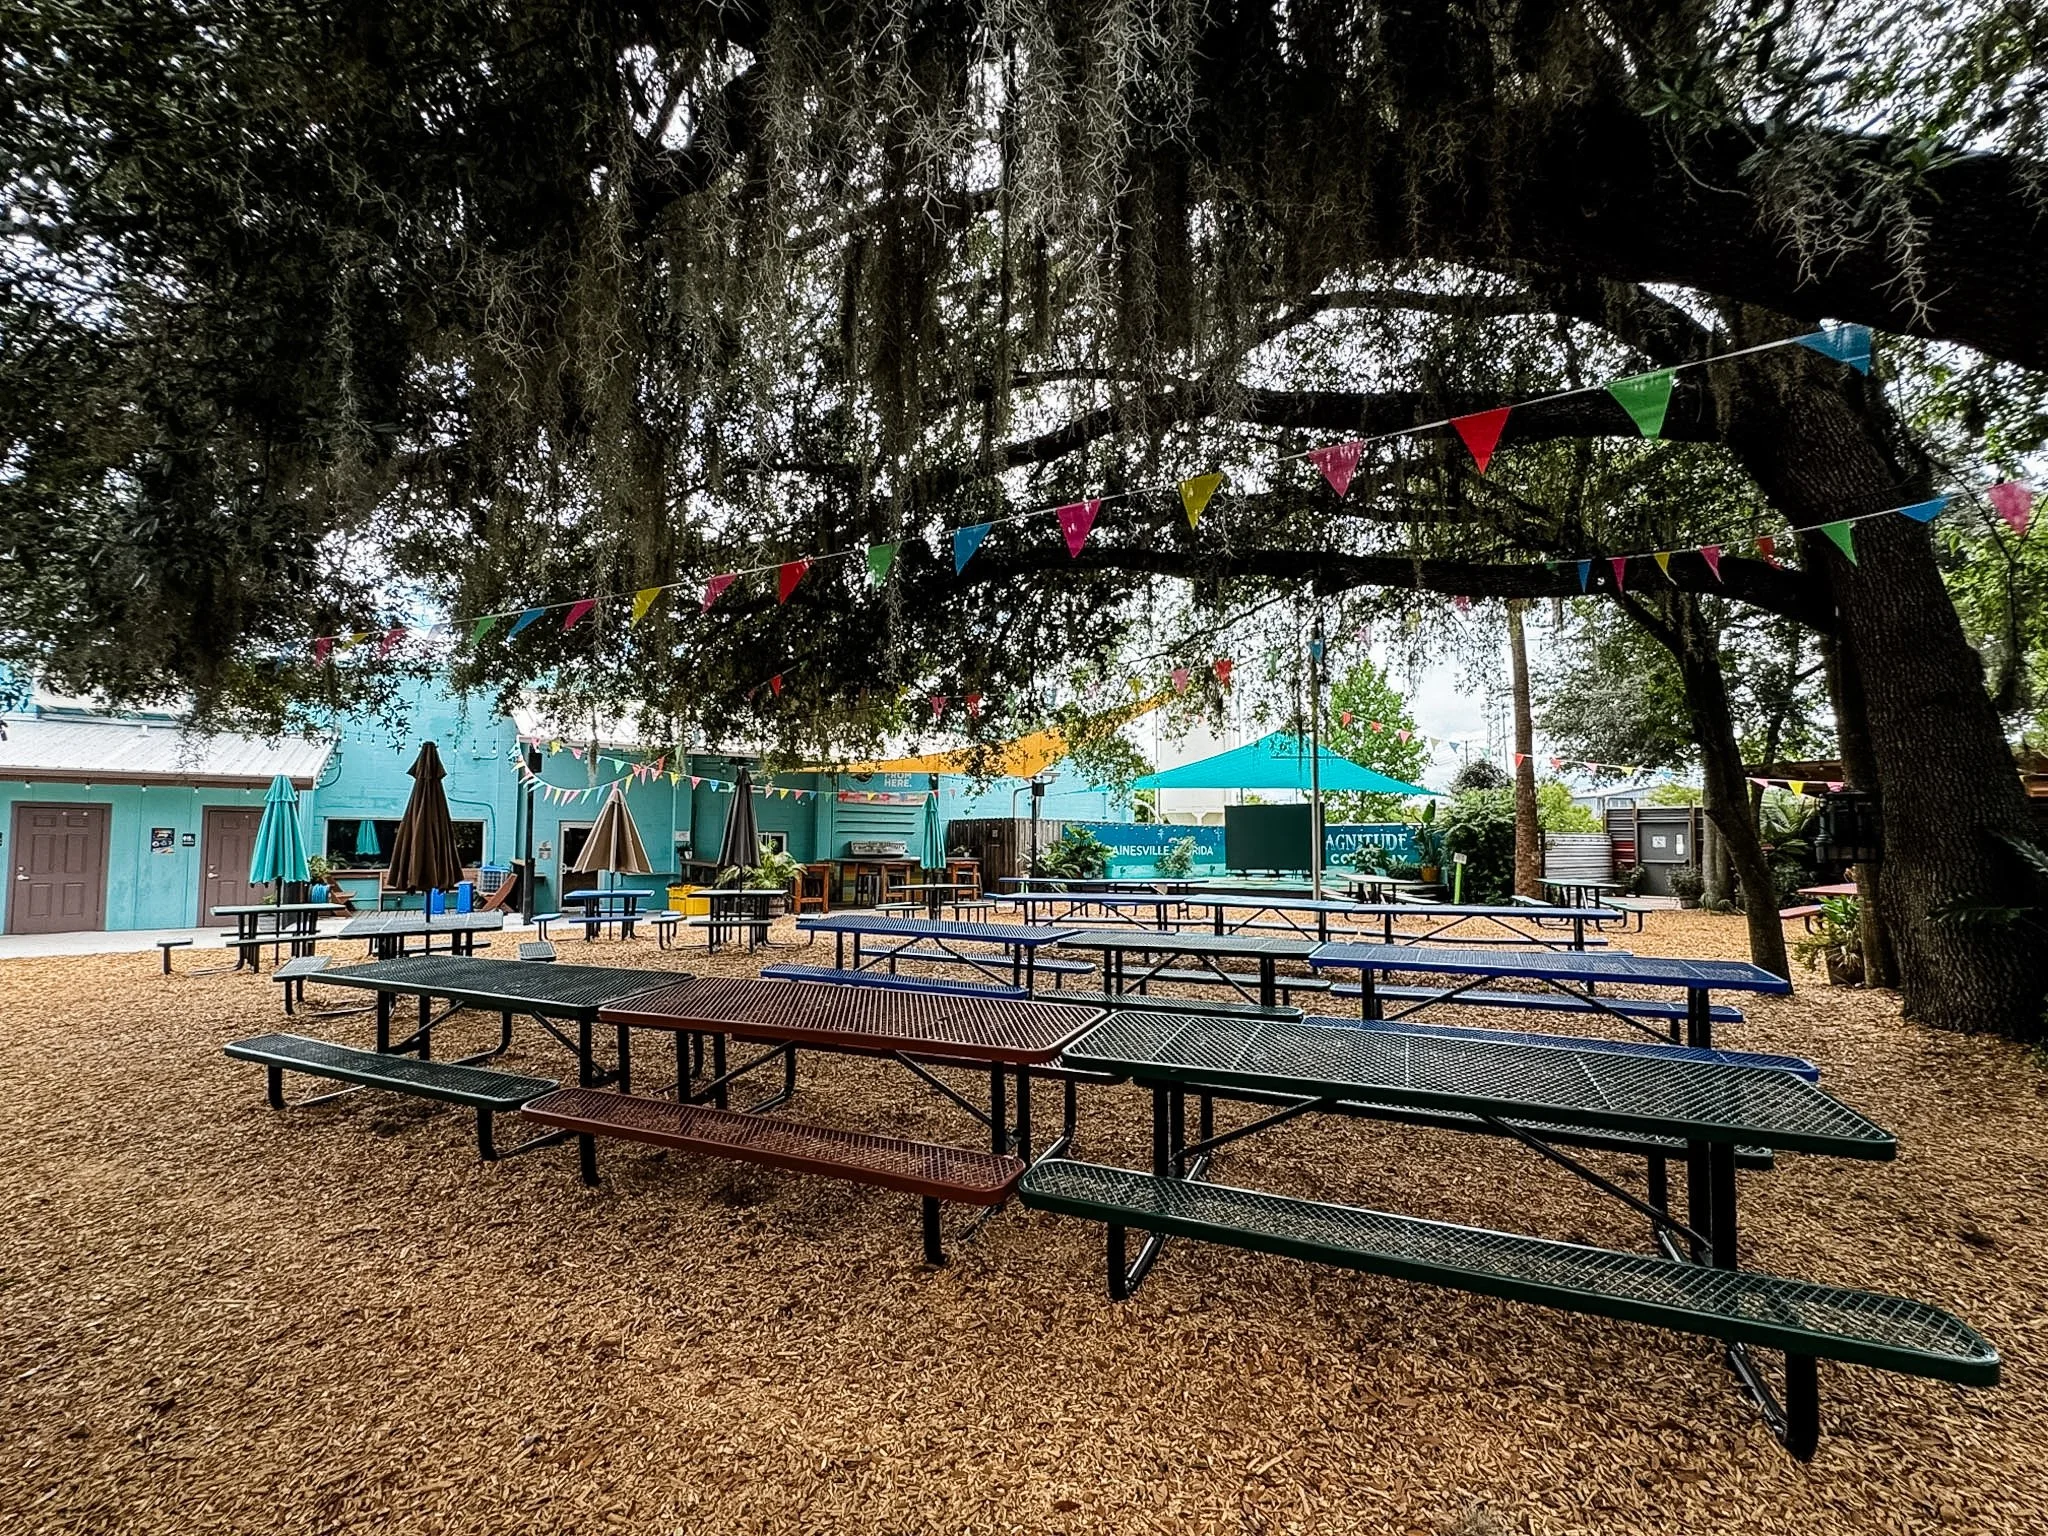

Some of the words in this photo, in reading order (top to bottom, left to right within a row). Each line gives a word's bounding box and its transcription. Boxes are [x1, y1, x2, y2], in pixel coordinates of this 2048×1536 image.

[884, 778, 912, 788] HERE.
[1325, 832, 1408, 851] AGNITUDE
[1110, 845, 1170, 856] AINESVILLE
